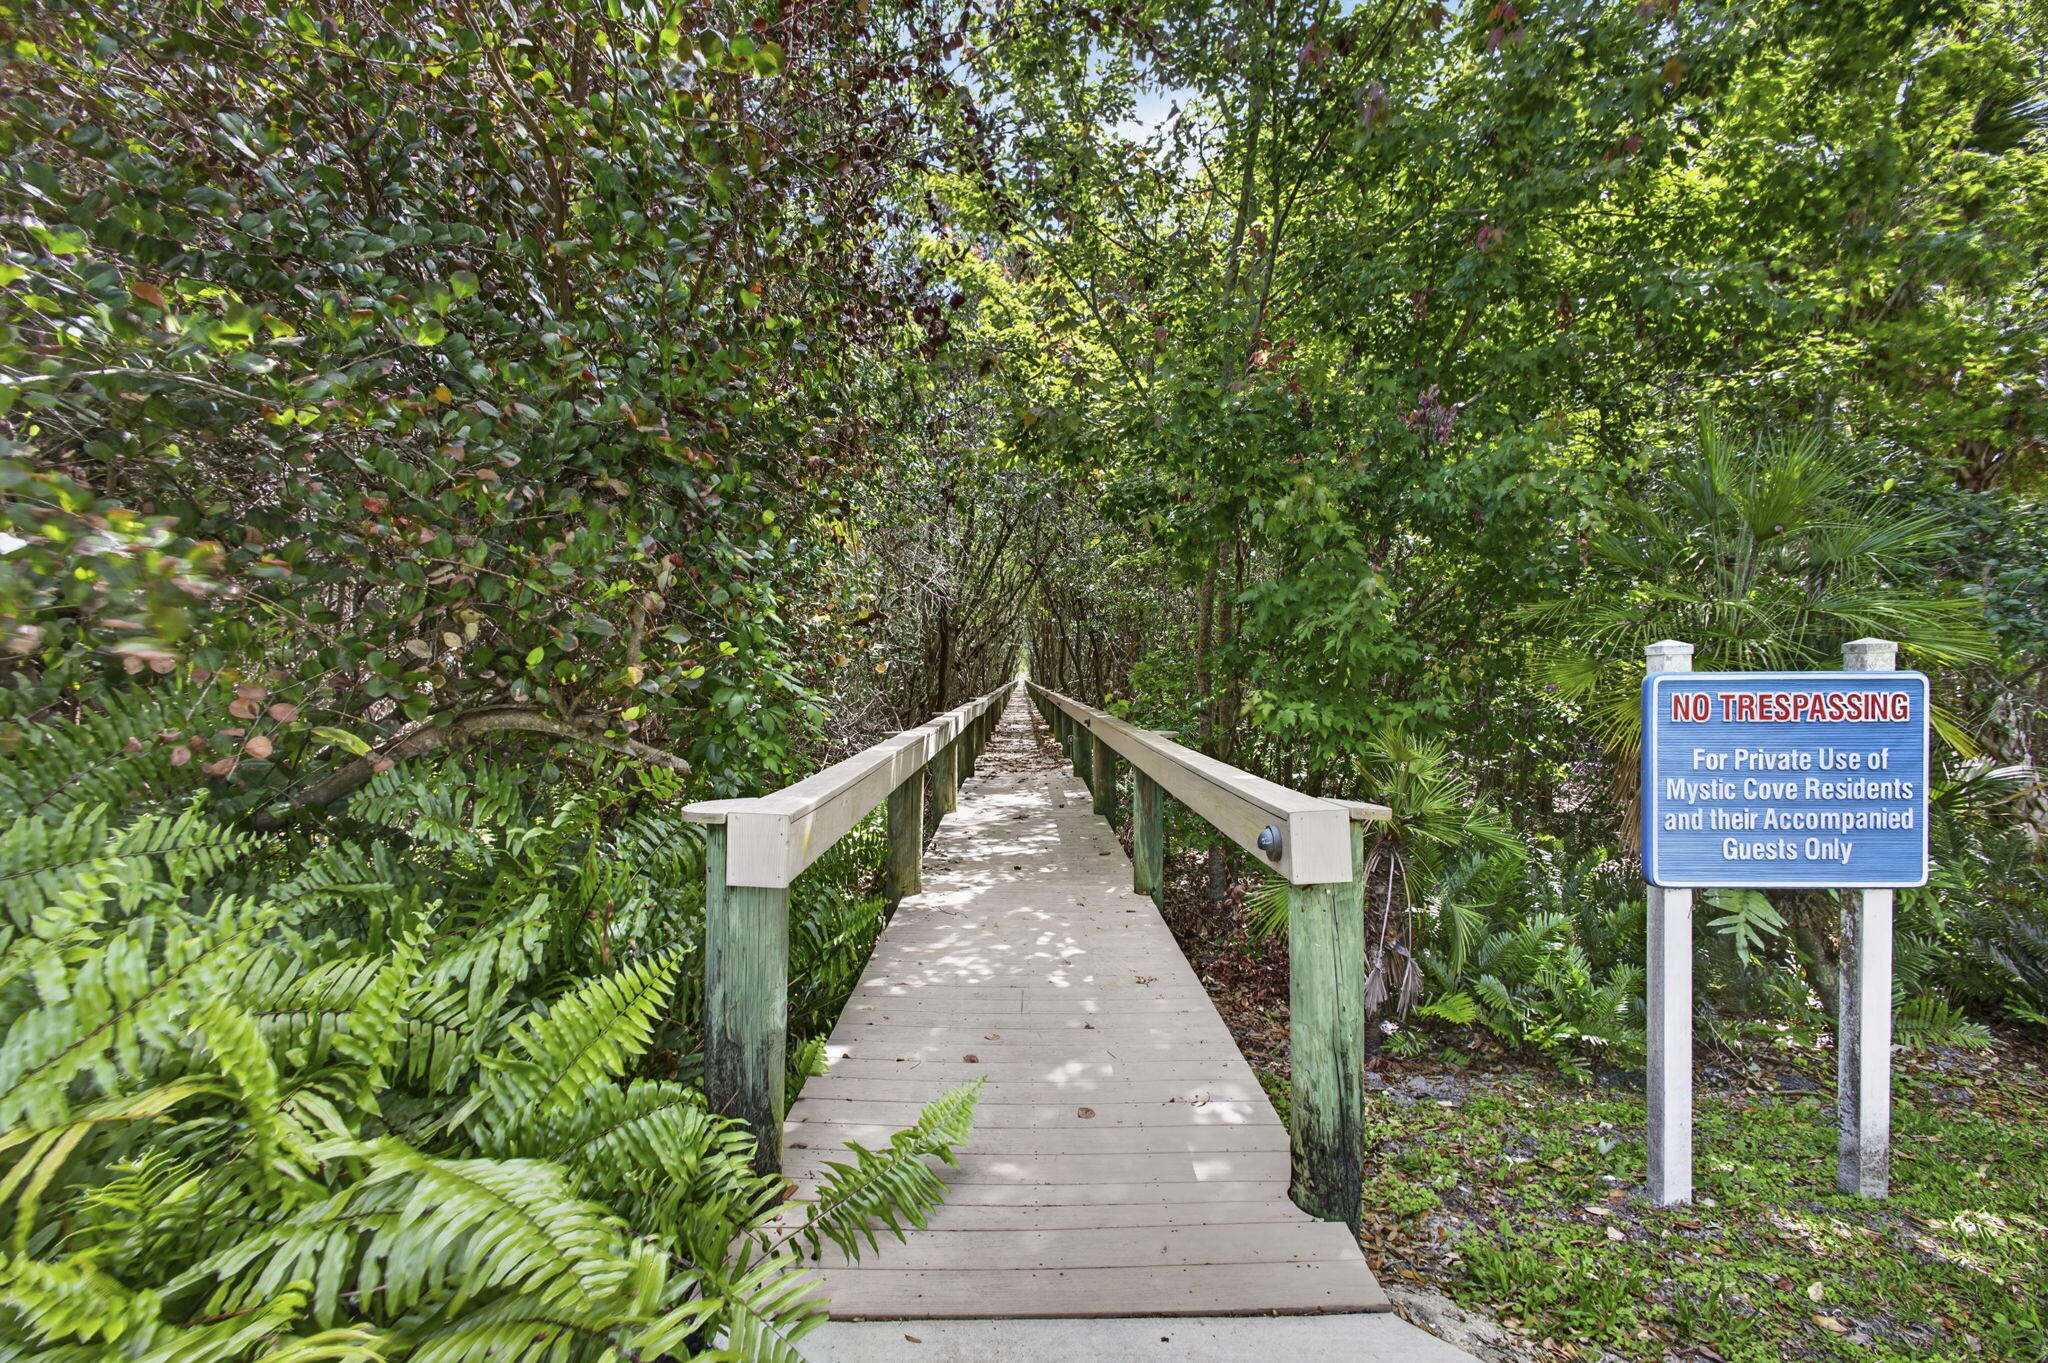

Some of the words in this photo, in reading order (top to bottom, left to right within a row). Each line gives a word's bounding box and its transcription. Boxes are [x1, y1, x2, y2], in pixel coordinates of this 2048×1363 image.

[1671, 692, 1712, 722] NO
[1718, 692, 1910, 722] TRESPASSING
[1692, 748, 1728, 770] For
[1735, 748, 1811, 770] Private
[1819, 748, 1861, 770] Use
[1868, 748, 1889, 770] of
[1666, 778, 1736, 804] Mystic
[1743, 778, 1798, 800] Cove
[1806, 778, 1913, 800] Residents
[1664, 808, 1703, 830] and
[1710, 808, 1758, 830] their
[1764, 808, 1914, 834] Accompanied
[1723, 838, 1798, 860] Guests
[1805, 838, 1852, 865] Only
